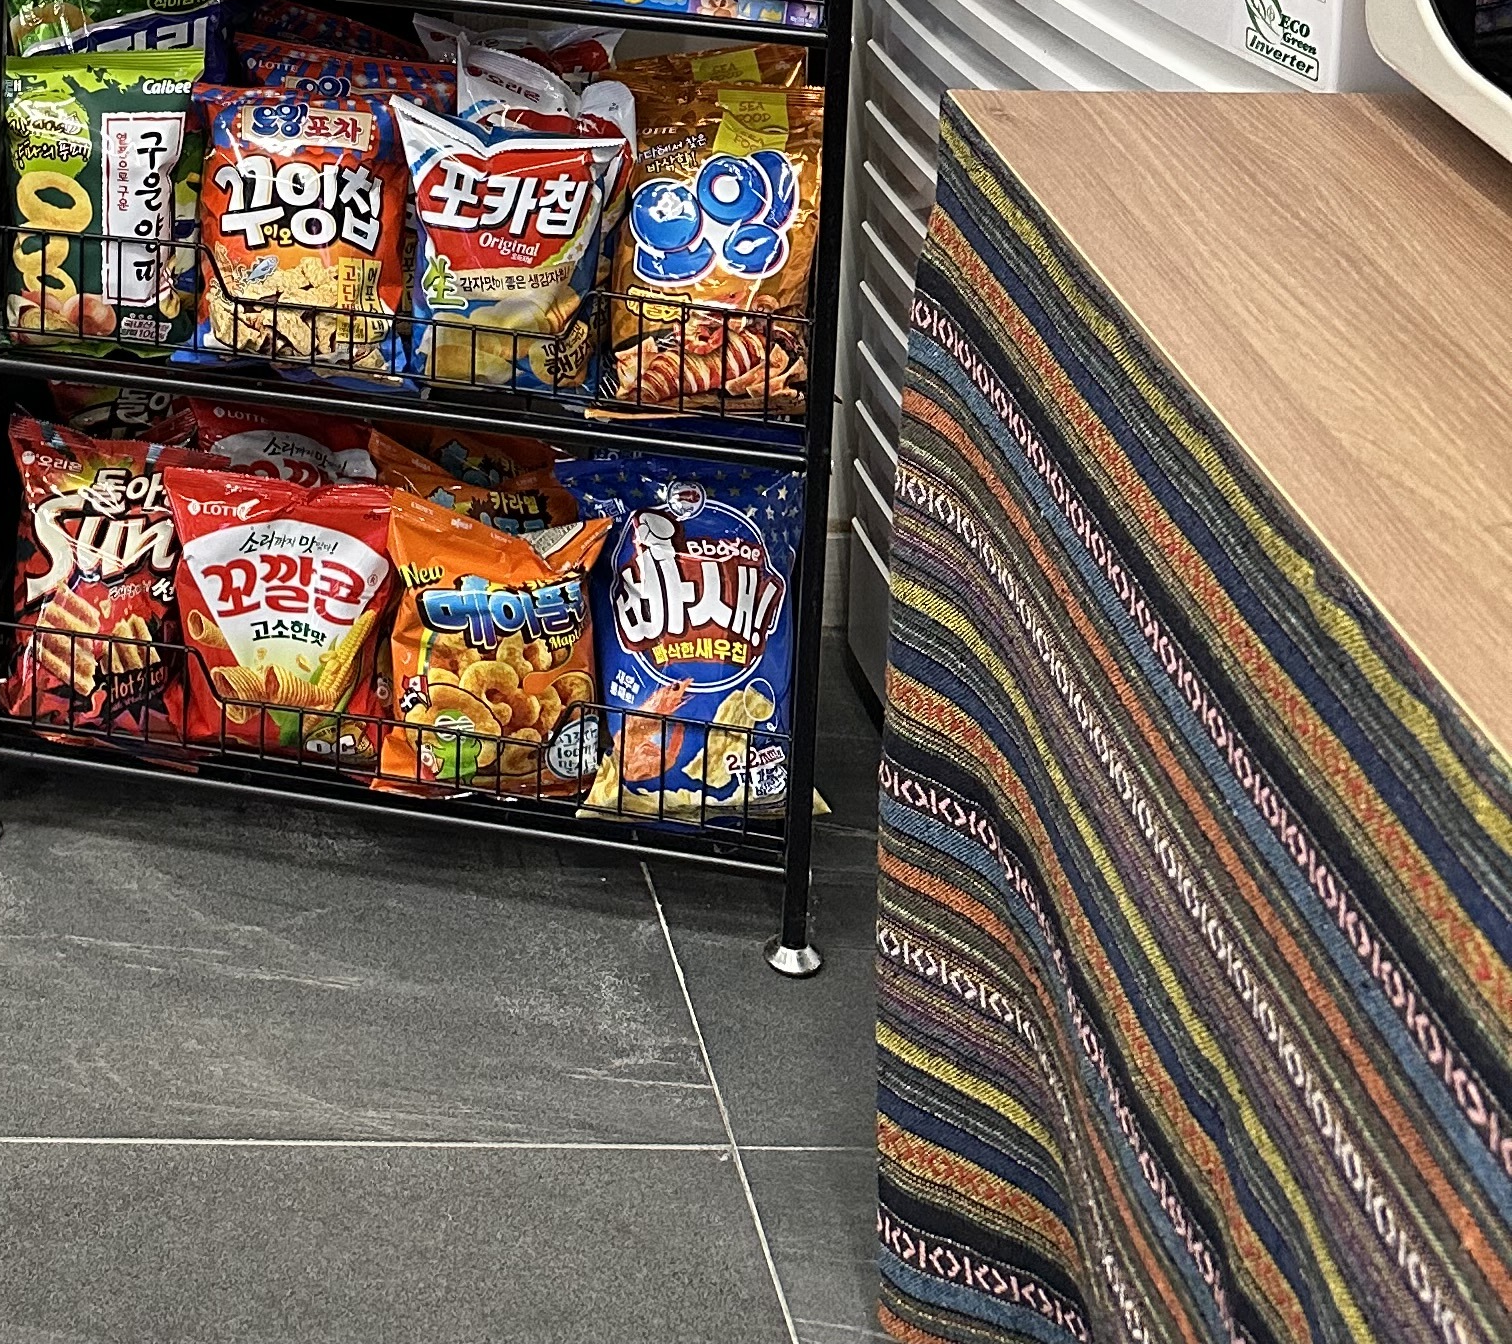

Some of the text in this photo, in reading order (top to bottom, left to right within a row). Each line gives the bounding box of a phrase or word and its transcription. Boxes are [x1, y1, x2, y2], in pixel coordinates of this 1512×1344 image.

[1278, 14, 1311, 38] ECO
[1249, 35, 1315, 74] Inverter
[1283, 32, 1318, 56] Green
[258, 59, 298, 73] LOTTE
[143, 79, 192, 95] Calbee
[738, 100, 764, 113] SEA
[133, 131, 168, 283] 구운양파
[424, 159, 590, 238] 포카칩
[479, 232, 539, 257] Original
[426, 256, 468, 309] 生
[460, 274, 505, 293] 감자맛이
[226, 409, 268, 423] LOTTE
[38, 455, 82, 474] 오리온
[490, 491, 539, 515] 카라멜
[239, 530, 297, 554] 소리까지
[686, 540, 762, 562] Bbasae
[399, 562, 446, 588] New
[201, 553, 366, 626] 꼬깔콘
[616, 554, 778, 648] 빠새!
[251, 619, 328, 648] 고소한맛
[696, 637, 748, 665] 새우칩
